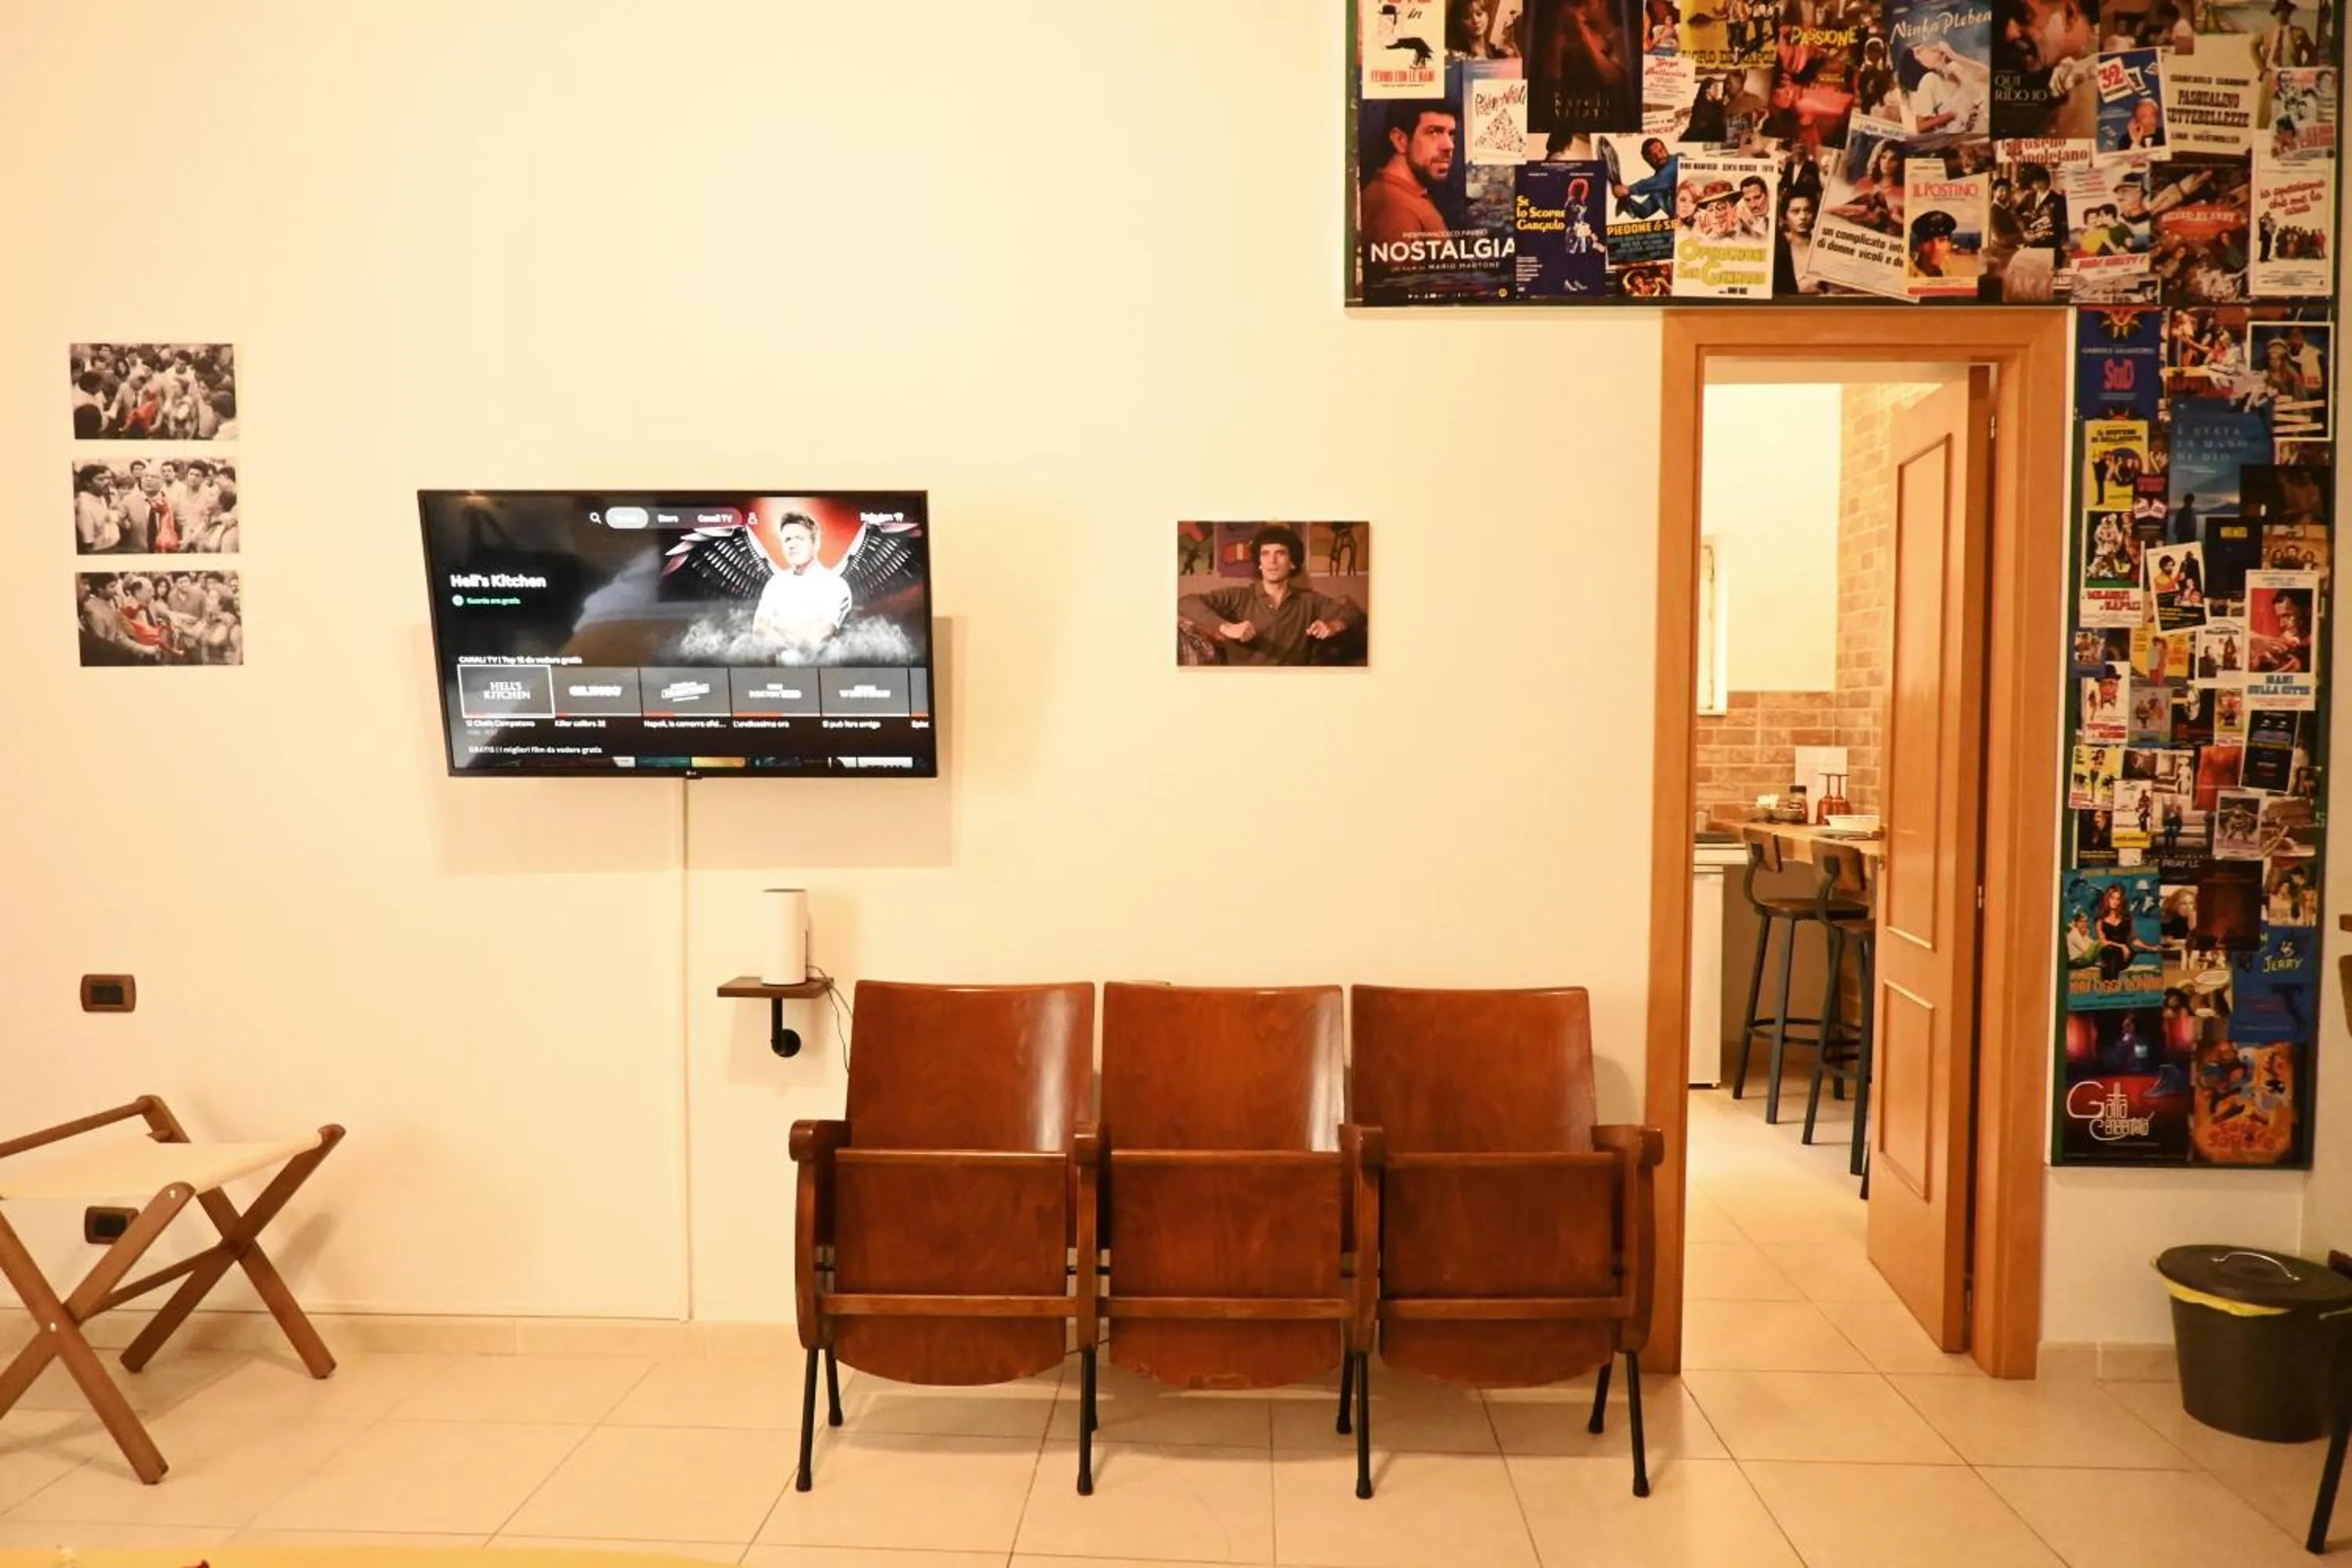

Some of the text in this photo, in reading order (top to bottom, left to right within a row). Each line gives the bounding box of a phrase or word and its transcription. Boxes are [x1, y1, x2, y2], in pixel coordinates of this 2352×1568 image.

[1890, 8, 1991, 44] Ninfa Plebea
[1994, 74, 2021, 88] QUI
[2098, 64, 2124, 89] 32
[1994, 89, 2049, 101] RIDO IO
[1913, 183, 1979, 197] IL POSTINO
[1606, 222, 1653, 235] PIEDONE
[1822, 227, 1834, 236] un
[1835, 228, 1886, 249] complicato
[1371, 237, 1515, 263] NOSTALGIA
[1817, 238, 1826, 249] di
[1828, 241, 1855, 256] donne
[1858, 249, 1883, 263] vicoli
[449, 573, 547, 588] Hell's Kitchen
[503, 656, 516, 666] Top
[490, 681, 522, 691] HELL'S
[483, 690, 531, 700] KITCHEN
